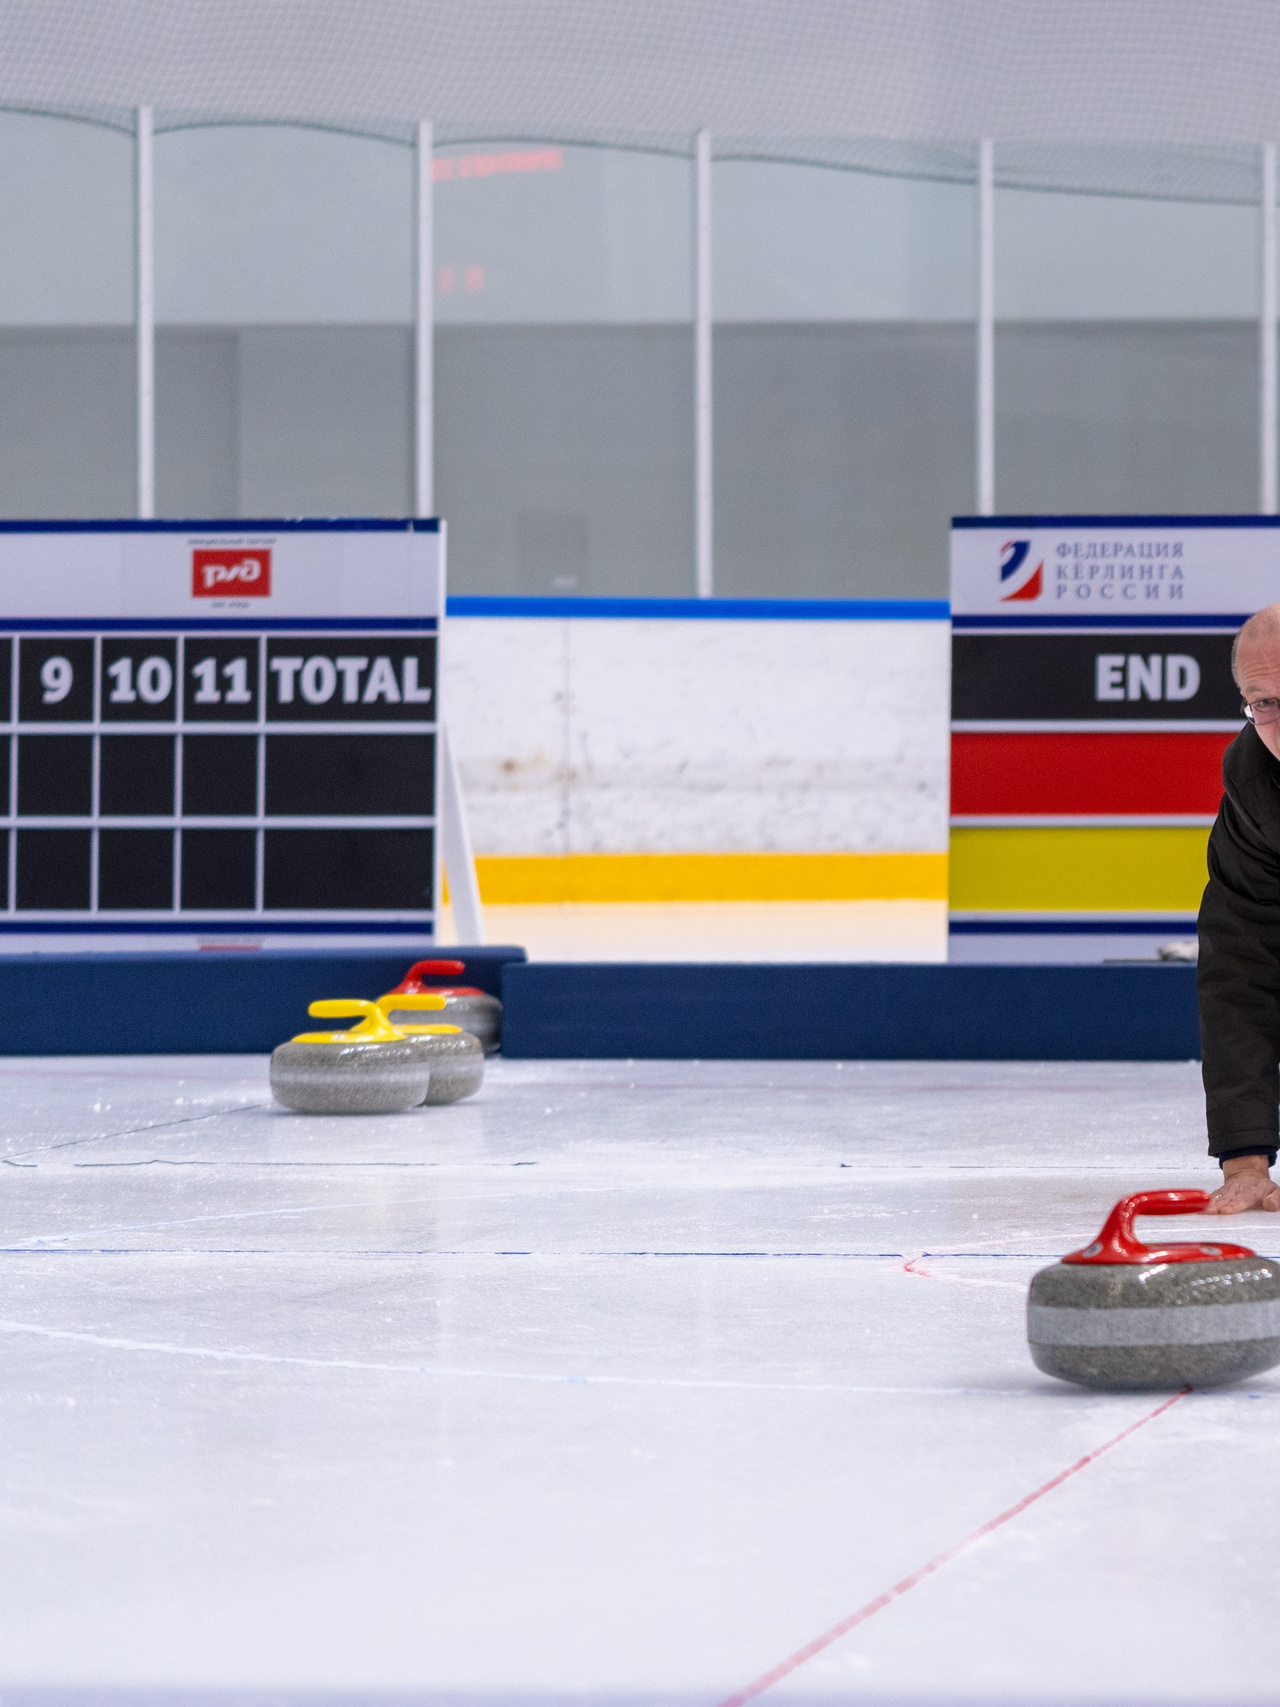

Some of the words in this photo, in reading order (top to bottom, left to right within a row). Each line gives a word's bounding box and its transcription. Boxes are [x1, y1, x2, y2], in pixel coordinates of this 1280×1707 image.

[1056, 542, 1184, 558] ФЕДЕРАЦИЯ
[1056, 561, 1184, 579] КЁРЛИНГА
[1056, 584, 1184, 599] РОССИИ
[41, 656, 73, 703] 9
[108, 656, 173, 703] 10
[193, 657, 252, 703] 11
[270, 656, 432, 704] TOTAL
[1095, 654, 1201, 701] END
